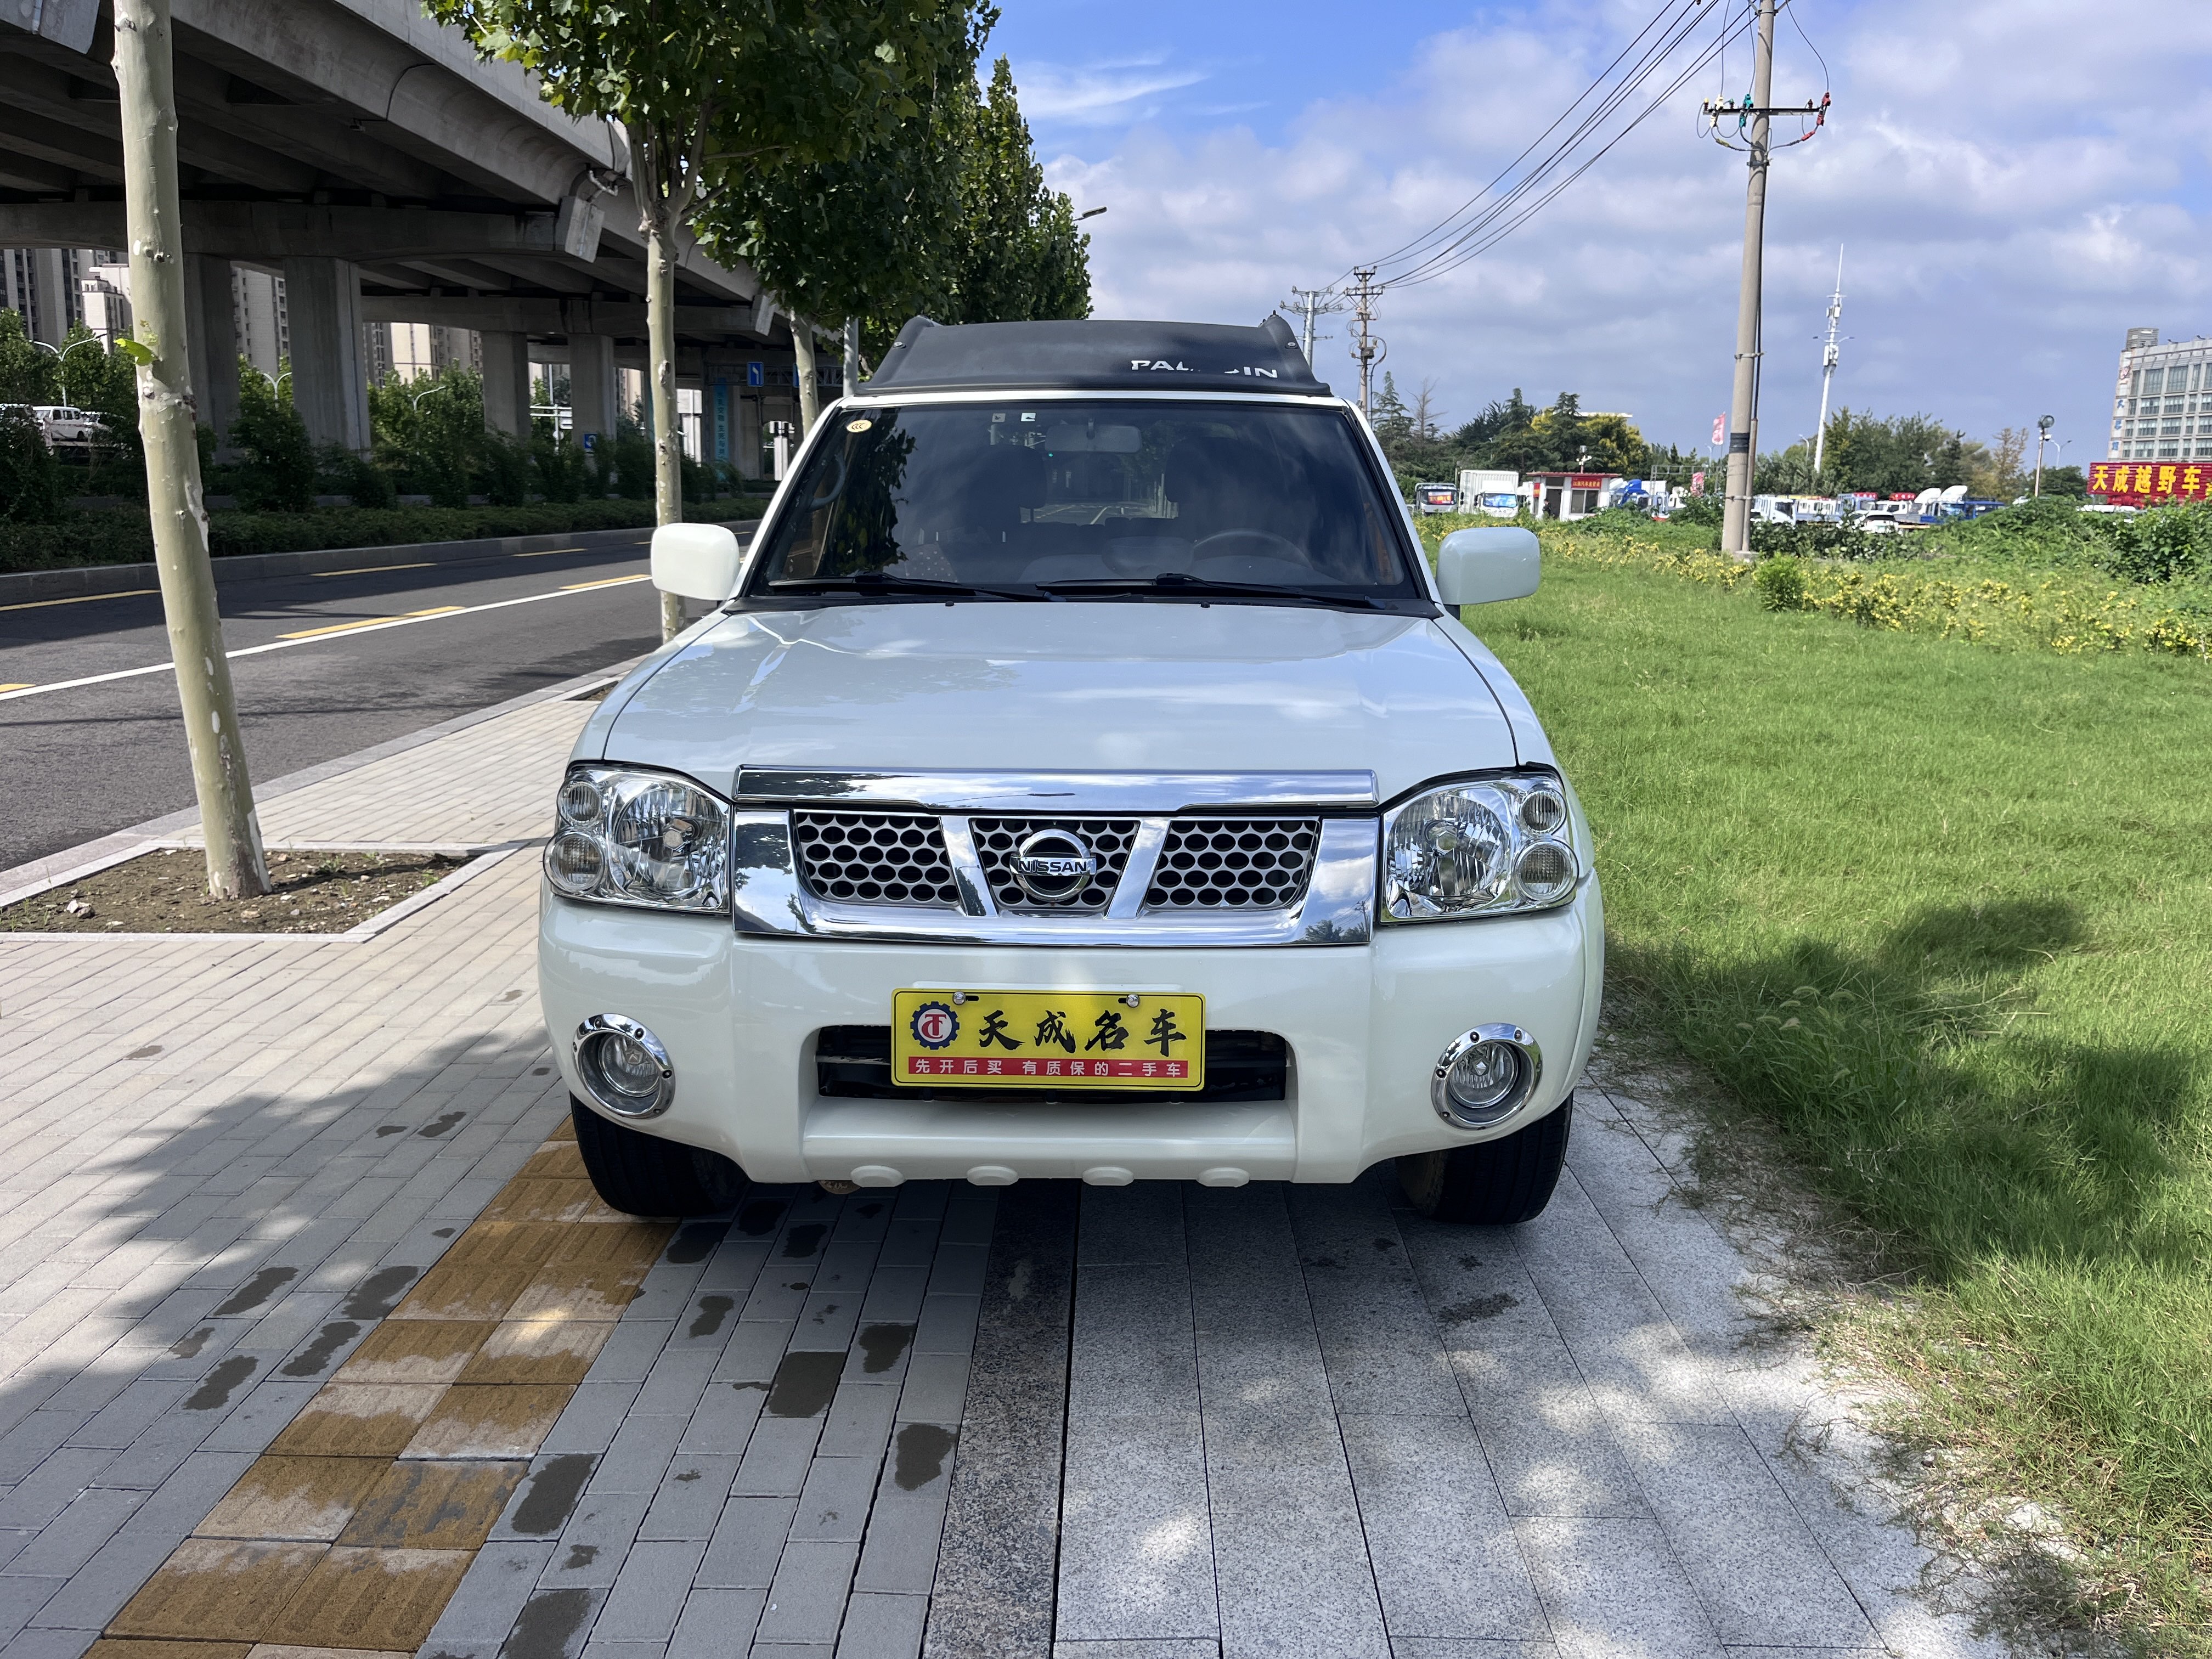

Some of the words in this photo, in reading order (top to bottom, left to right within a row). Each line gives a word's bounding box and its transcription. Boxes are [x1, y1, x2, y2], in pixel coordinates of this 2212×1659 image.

[1131, 360, 1278, 379] PALIN
[2092, 465, 2212, 494] 天成越野车
[1018, 859, 1087, 873] NISSAN
[979, 1008, 1187, 1057] 天成名车
[916, 1059, 1003, 1074] 先开后买
[1022, 1060, 1181, 1077] 有质保的二手车
